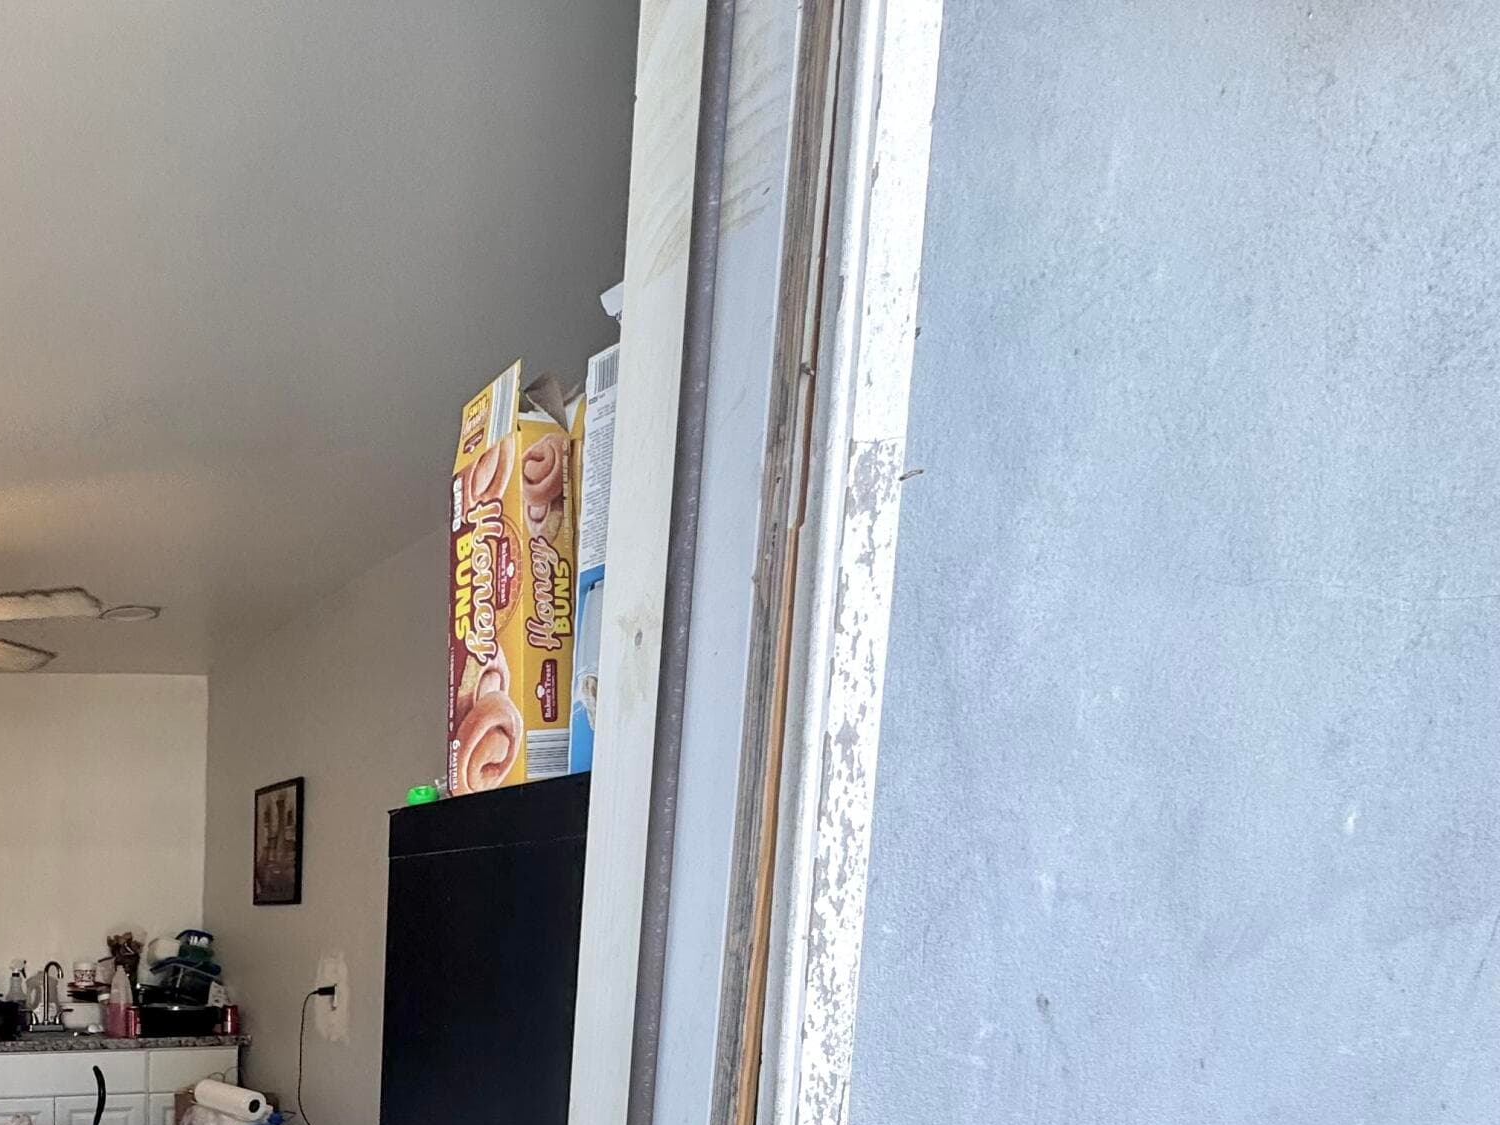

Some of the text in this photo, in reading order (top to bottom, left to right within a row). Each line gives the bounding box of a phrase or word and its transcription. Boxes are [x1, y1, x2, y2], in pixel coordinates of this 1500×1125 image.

[455, 532, 473, 640] BUNS
[466, 499, 503, 665] Honey
[526, 537, 561, 651] Honey
[554, 560, 572, 634] BUNS
[452, 739, 461, 750] 6
